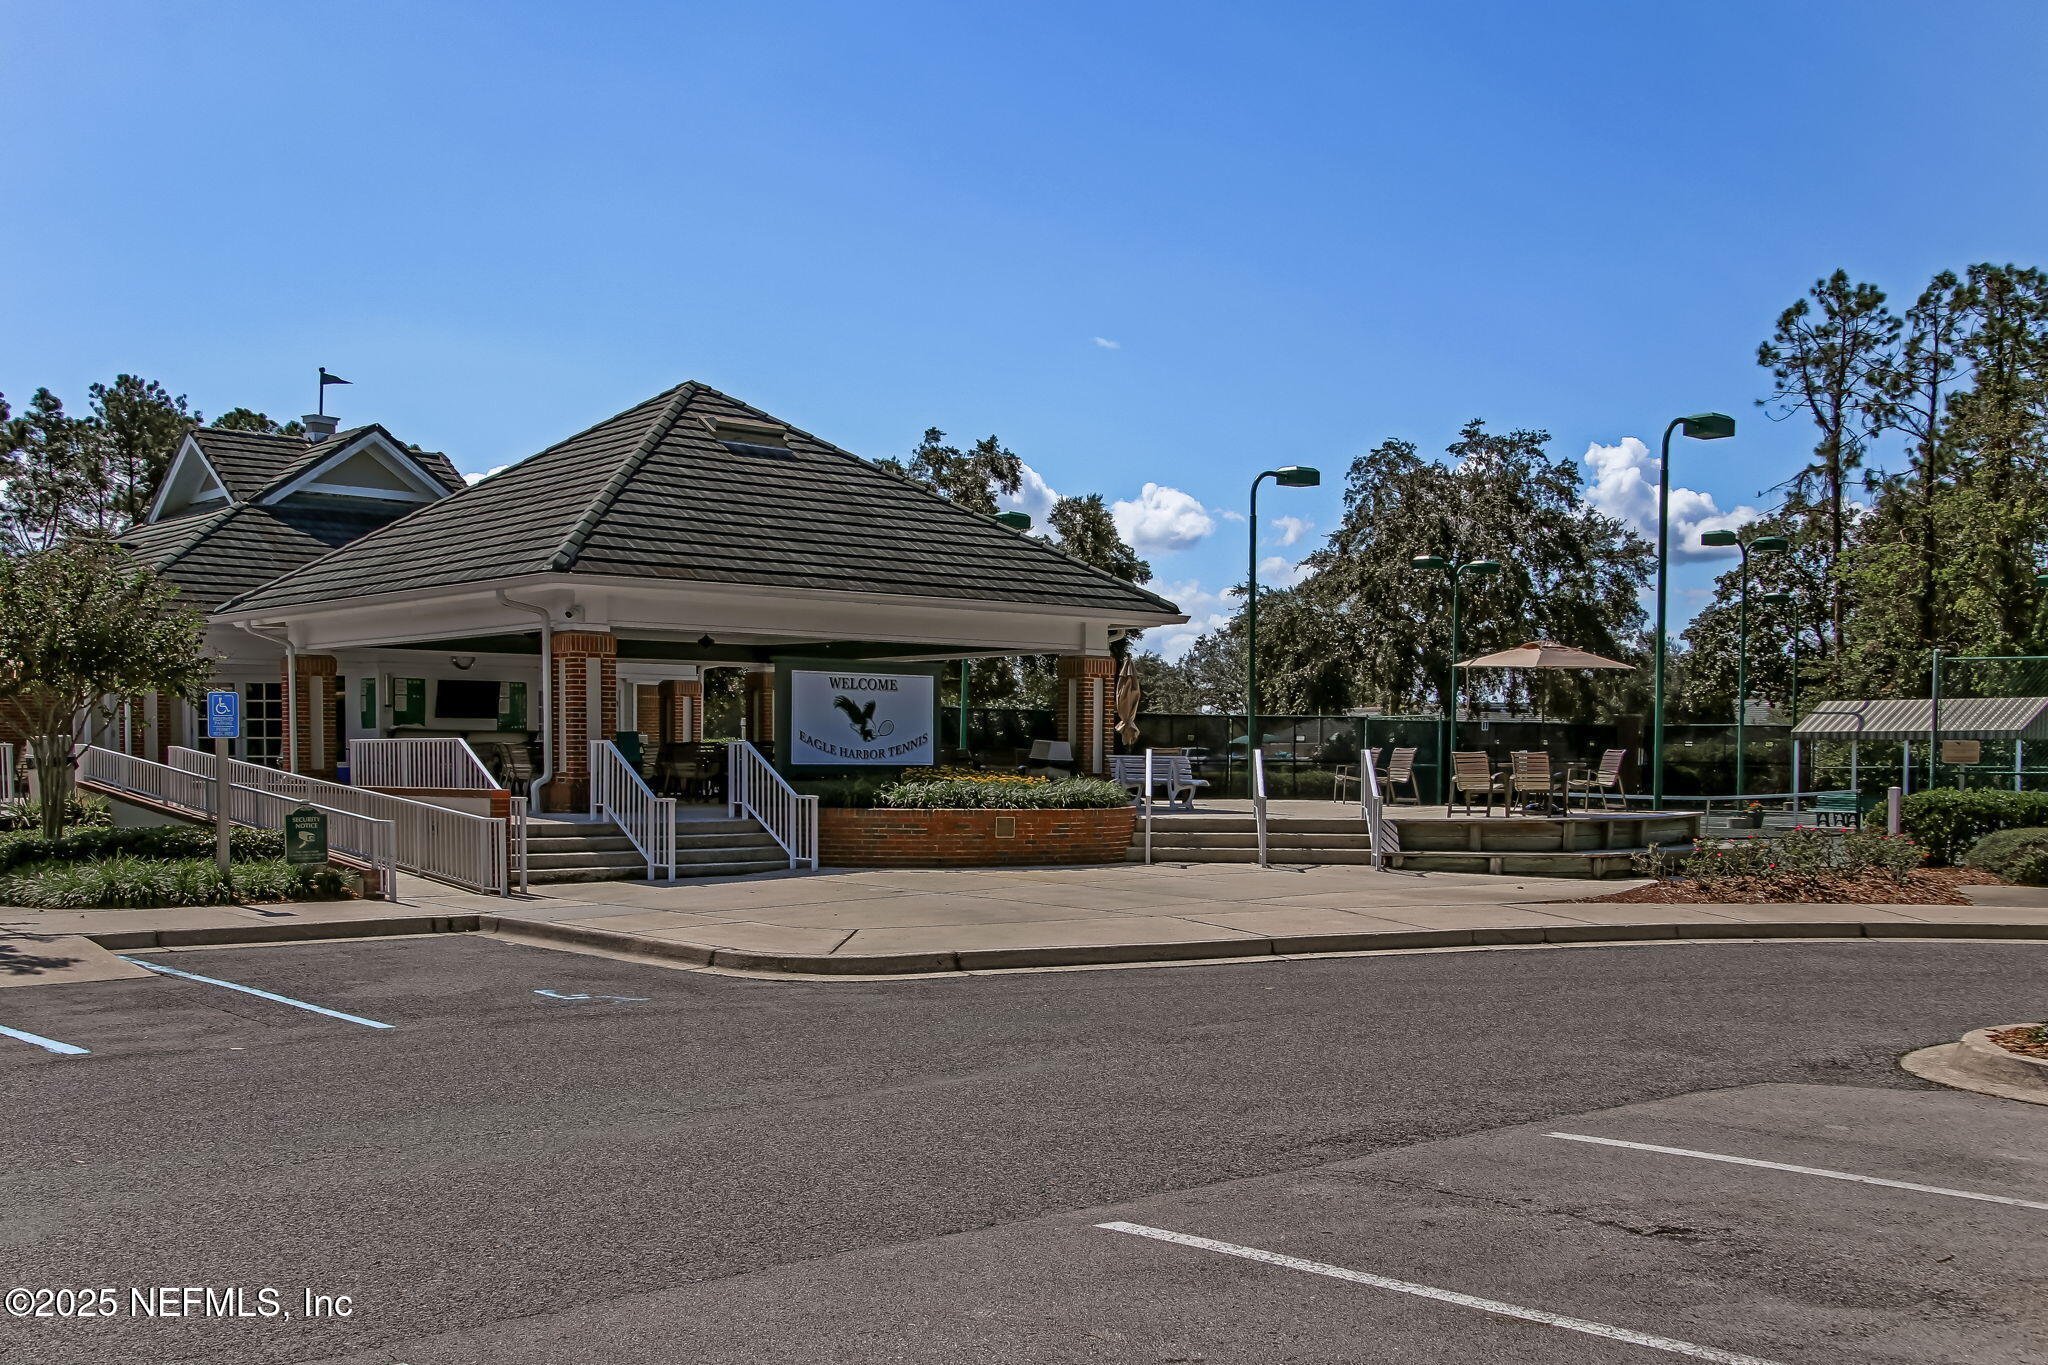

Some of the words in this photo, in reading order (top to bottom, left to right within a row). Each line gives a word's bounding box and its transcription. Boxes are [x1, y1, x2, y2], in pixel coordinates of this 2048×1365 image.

[829, 676, 898, 691] WELCOME
[800, 730, 836, 755] EAGLE
[839, 746, 885, 760] HARBOR
[887, 732, 928, 757] TENNIS
